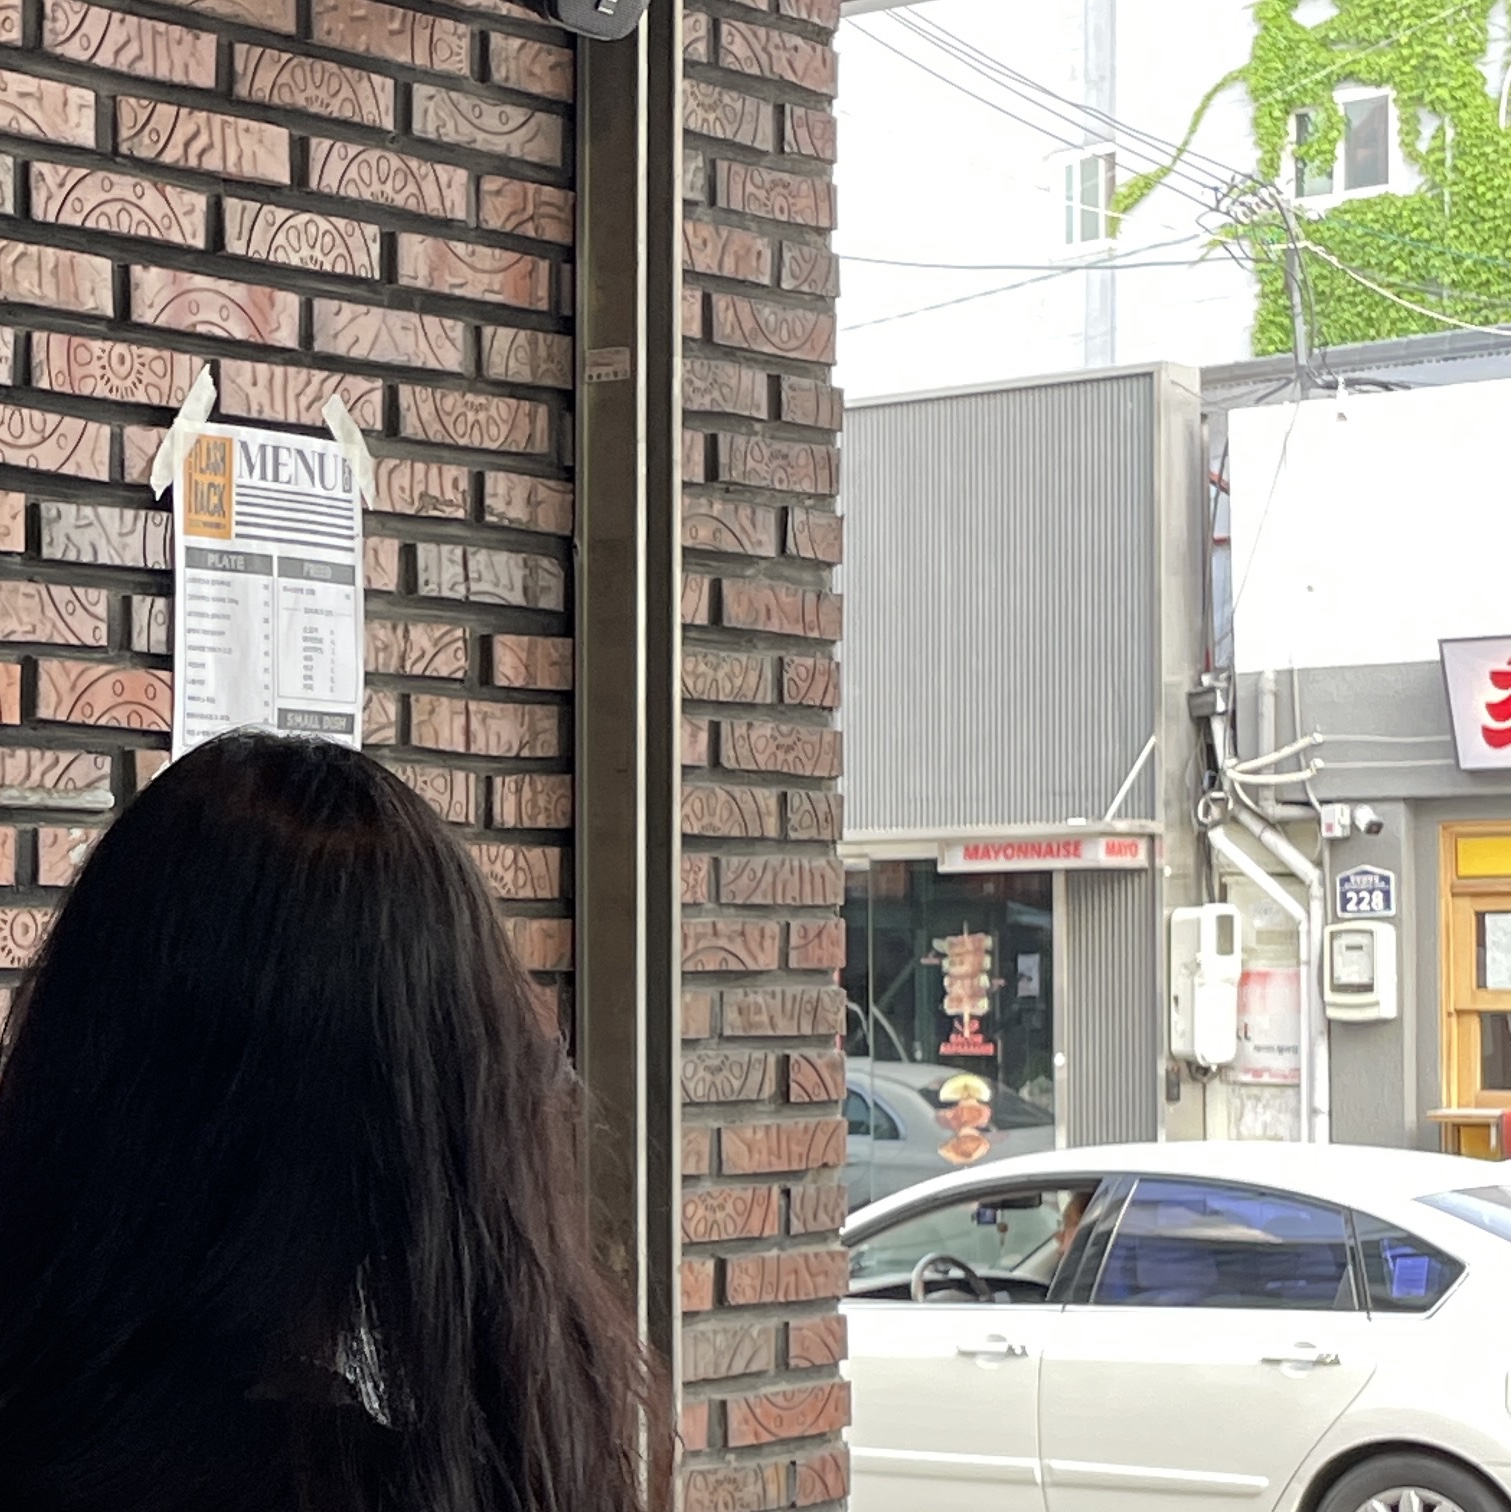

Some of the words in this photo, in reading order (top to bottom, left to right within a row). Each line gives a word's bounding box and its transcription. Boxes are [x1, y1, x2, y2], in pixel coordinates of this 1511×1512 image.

[238, 440, 338, 491] MENU
[207, 553, 245, 570] PLATE
[962, 840, 1082, 861] MAYONNAISE
[1105, 838, 1139, 858] MAYO
[1346, 890, 1384, 911] 228
